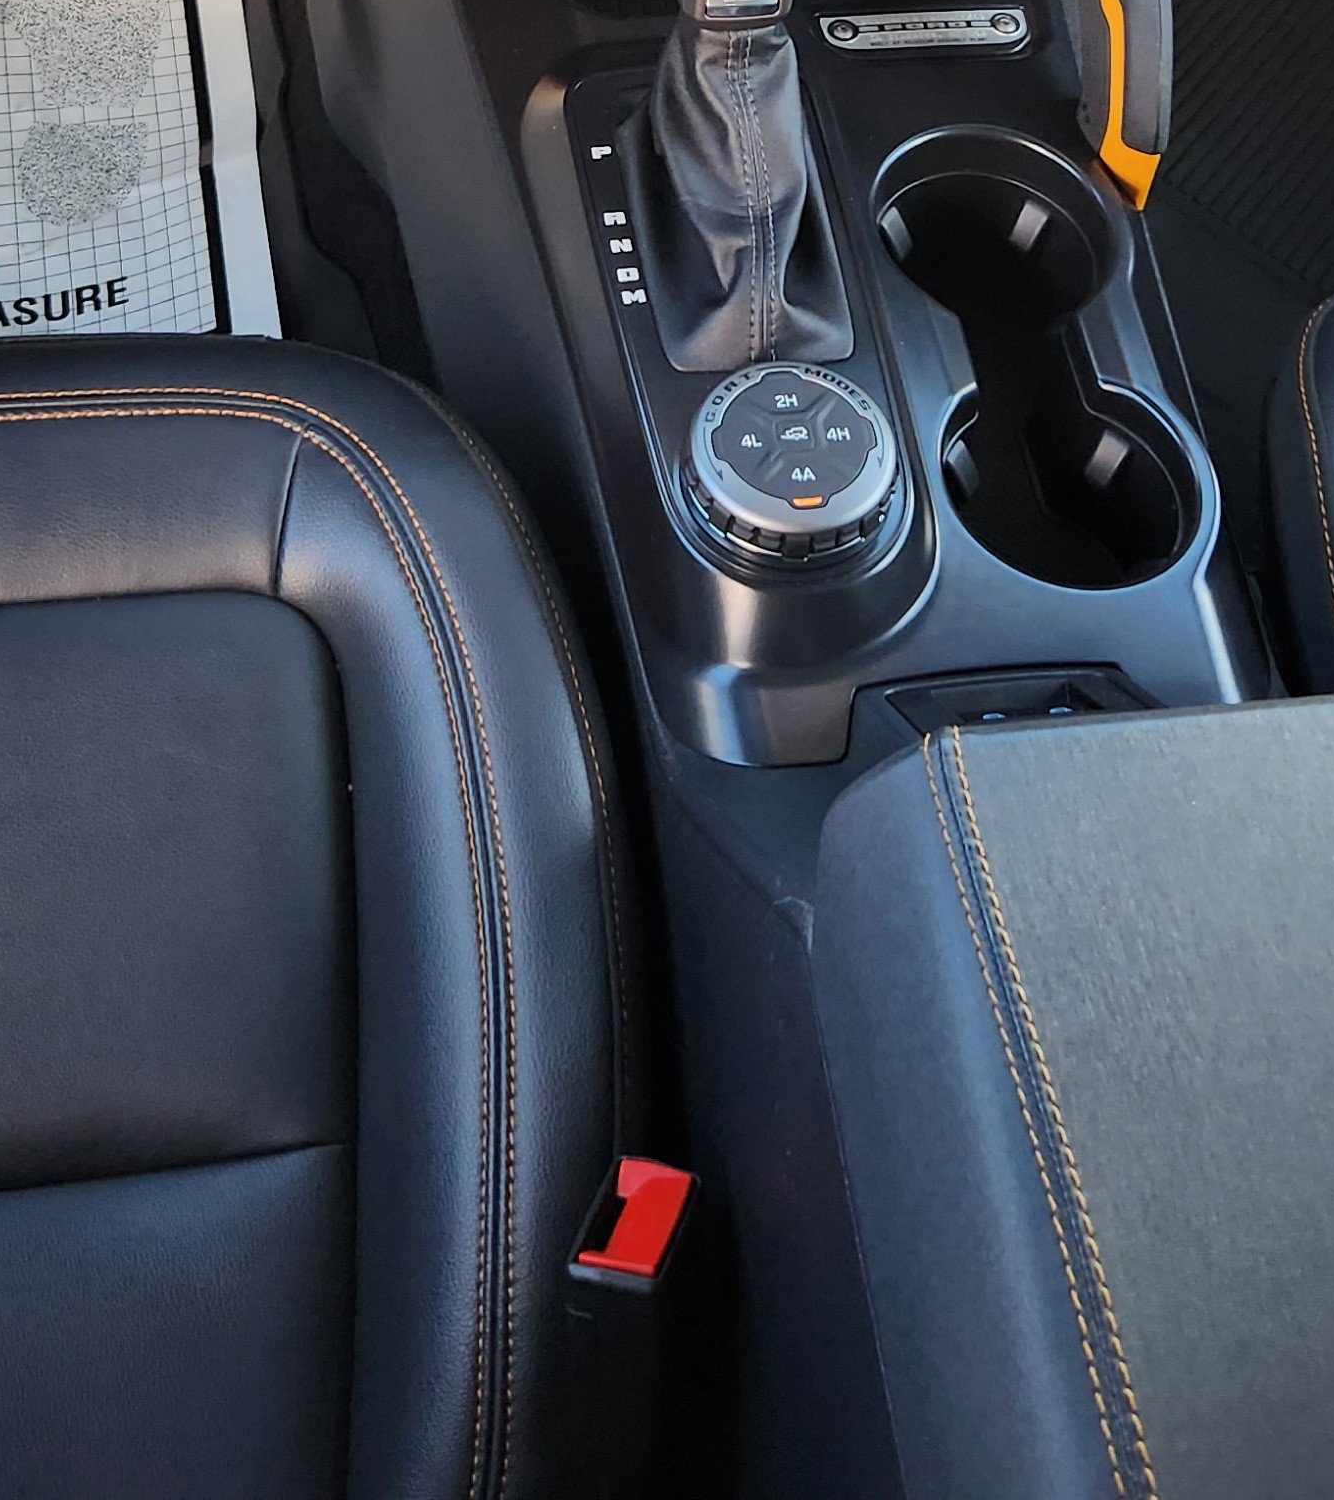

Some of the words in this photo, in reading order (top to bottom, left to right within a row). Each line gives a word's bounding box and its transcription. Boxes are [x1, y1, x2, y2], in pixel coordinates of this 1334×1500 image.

[590, 145, 613, 160] P
[609, 238, 634, 254] N
[617, 267, 640, 283] D
[621, 288, 648, 305] M
[803, 366, 872, 411] MODES
[774, 394, 799, 409] 2H
[740, 434, 763, 449] 4L
[826, 426, 851, 442] 4H
[791, 467, 816, 483] 4A
